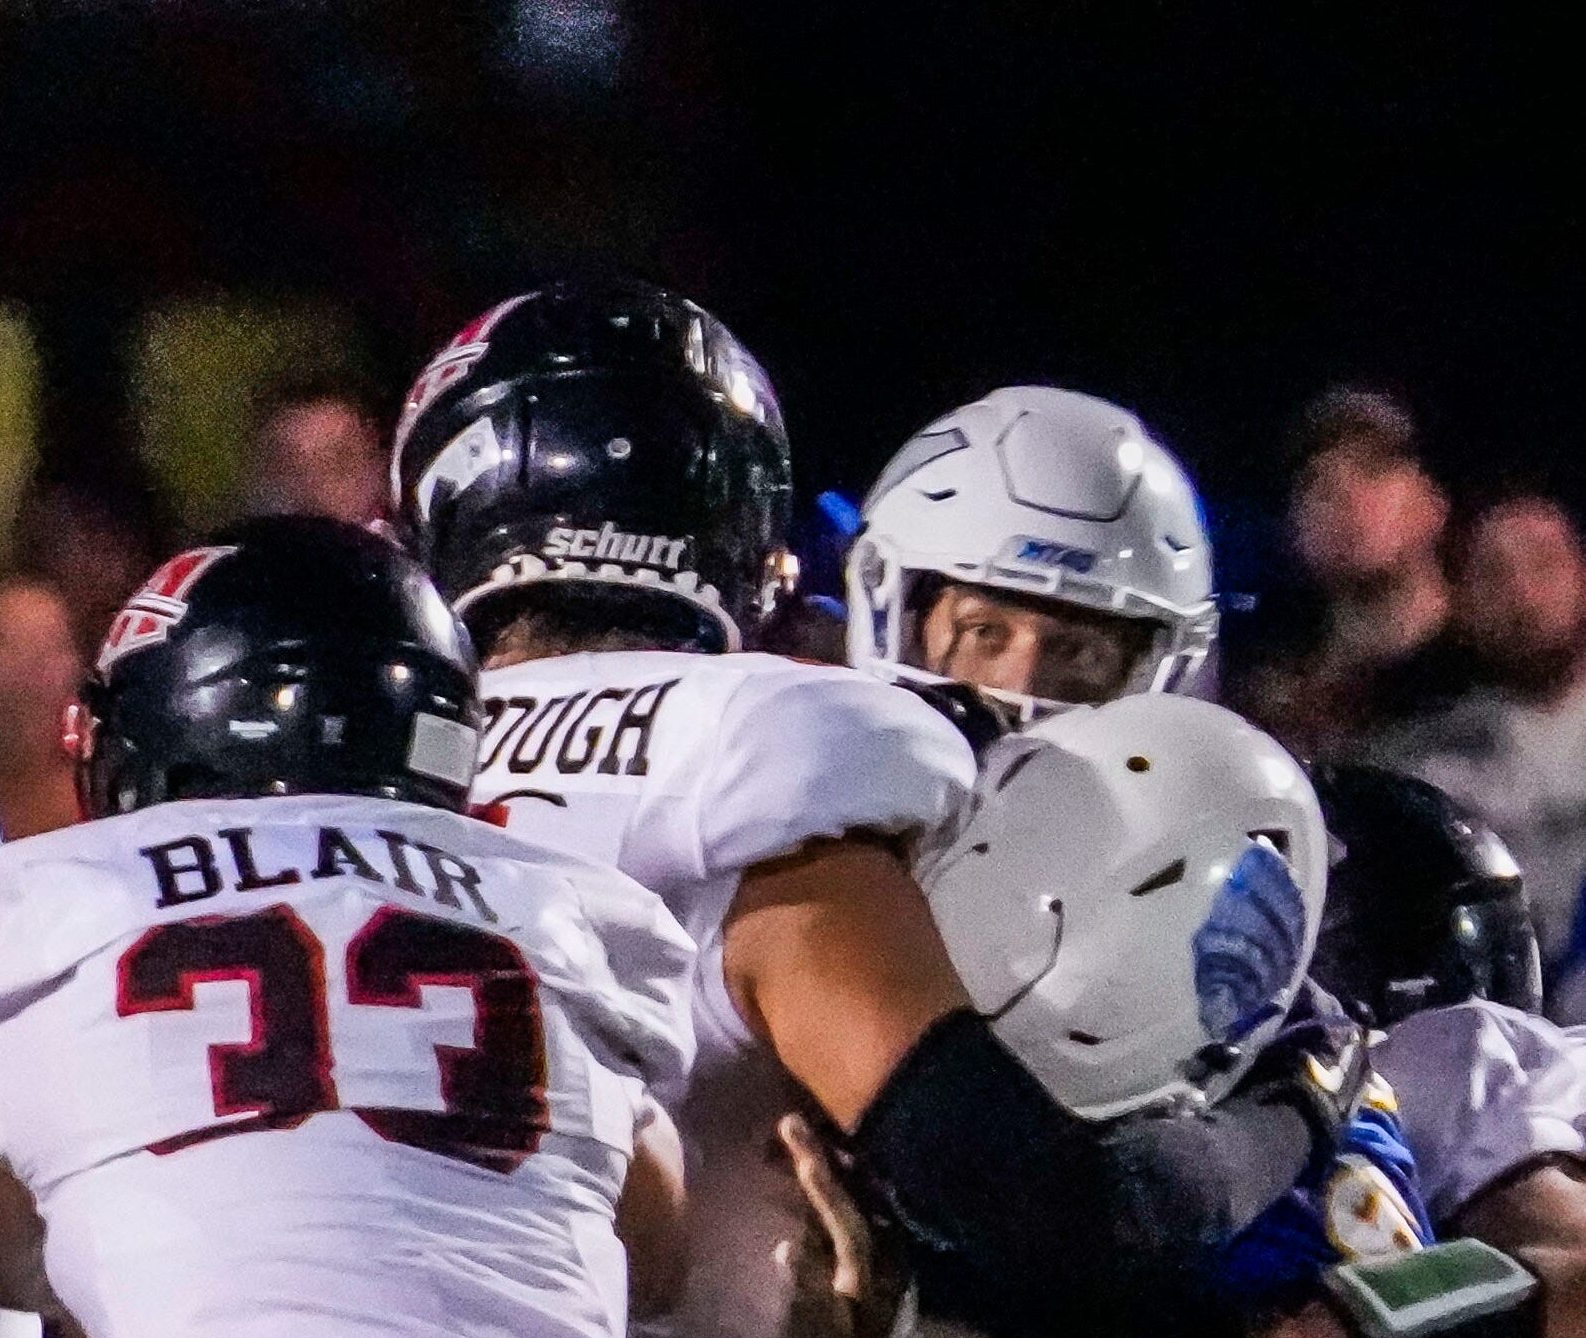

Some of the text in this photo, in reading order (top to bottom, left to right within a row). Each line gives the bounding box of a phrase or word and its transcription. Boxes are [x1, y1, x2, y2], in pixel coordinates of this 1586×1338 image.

[479, 677, 682, 777] OUGH
[139, 825, 499, 924] BLAIR
[115, 904, 552, 1175] 33
